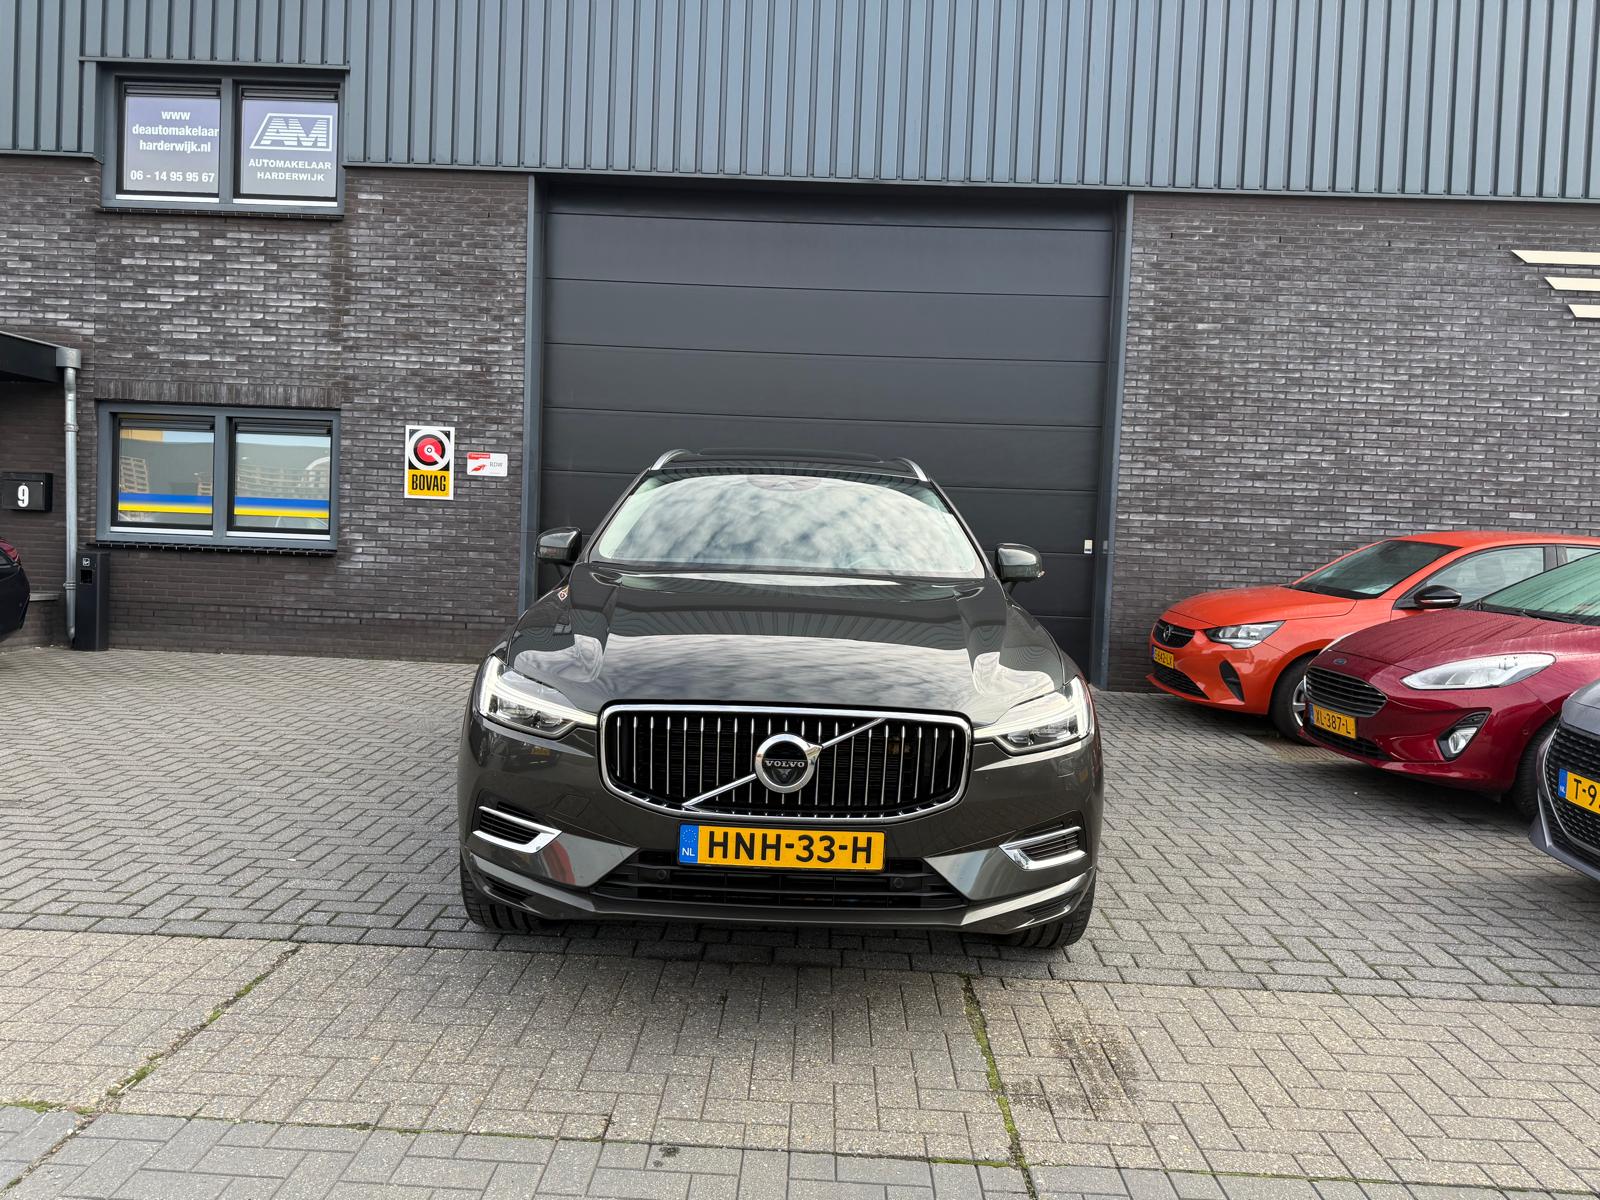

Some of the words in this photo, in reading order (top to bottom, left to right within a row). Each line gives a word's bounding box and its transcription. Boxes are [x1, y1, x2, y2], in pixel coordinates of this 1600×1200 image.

[161, 111, 190, 121] www
[132, 124, 220, 137] deautomakelaar
[260, 118, 328, 147] AM
[139, 140, 211, 153] harderwijk.nl
[248, 159, 332, 170] AUTOMAKELAAR
[130, 170, 143, 181] 06
[154, 171, 167, 181] 14
[170, 171, 183, 182] 95
[185, 172, 199, 182] 95
[201, 173, 215, 183] 67
[257, 171, 325, 182] HARDERWIJK
[411, 474, 446, 492] BOVAG
[17, 485, 29, 507] 9
[765, 760, 805, 768] VOLVO
[681, 847, 696, 857] NL
[708, 830, 873, 864] HNH-33-H
